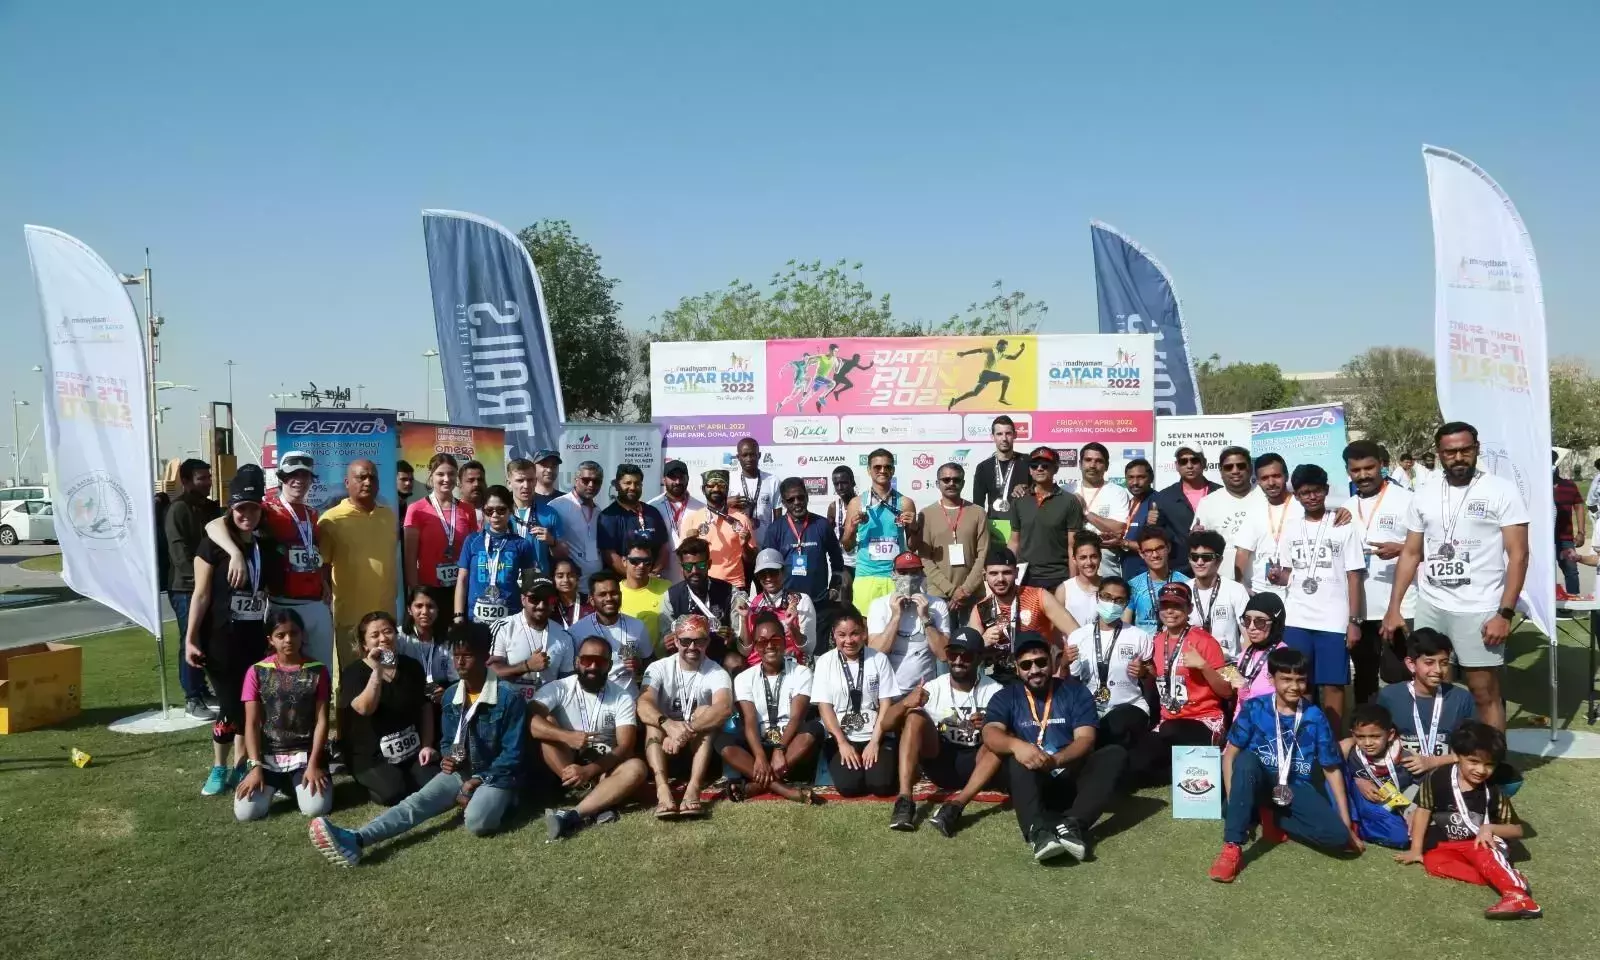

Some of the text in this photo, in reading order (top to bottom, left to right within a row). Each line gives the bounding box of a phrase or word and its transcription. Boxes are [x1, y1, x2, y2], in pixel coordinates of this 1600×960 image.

[664, 372, 755, 385] QATAR RUN
[1049, 367, 1140, 379] QATAR RUN
[721, 382, 755, 393] 2022
[1107, 378, 1140, 389] 2022
[287, 420, 377, 435] CASINO
[913, 457, 932, 465] ROYAL
[875, 544, 893, 554] 967
[294, 553, 319, 564] 166
[1429, 562, 1465, 577] 1258
[476, 606, 505, 618] 1520
[386, 734, 417, 756] 1396
[1445, 824, 1469, 837] 1053
